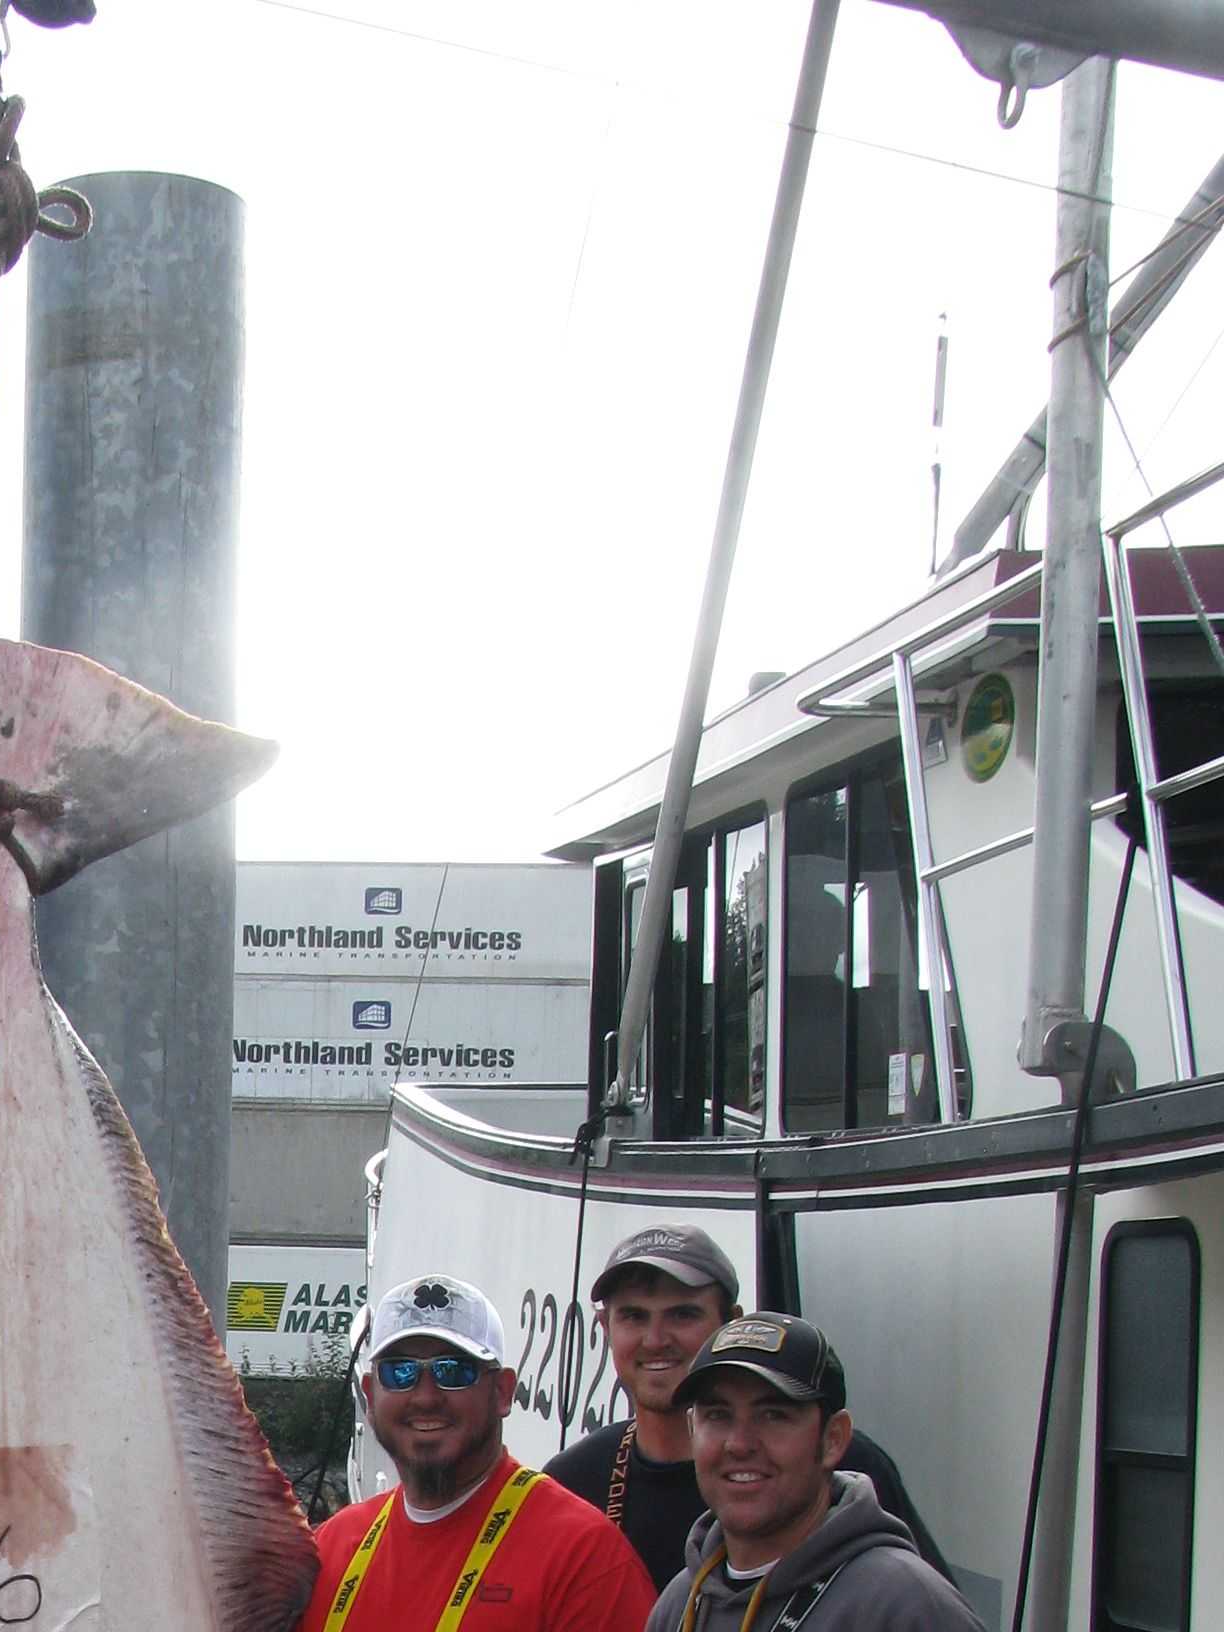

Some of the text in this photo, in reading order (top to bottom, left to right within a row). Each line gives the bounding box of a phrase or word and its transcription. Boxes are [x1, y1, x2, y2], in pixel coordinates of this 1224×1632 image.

[242, 924, 522, 951] Northland Services
[247, 951, 517, 961] MARINE TRANSPORTATION
[232, 1039, 515, 1069] Northland Services
[325, 1069, 512, 1080] TRANSPORTATION
[291, 1283, 368, 1309] ALAS
[283, 1309, 354, 1335] MAR
